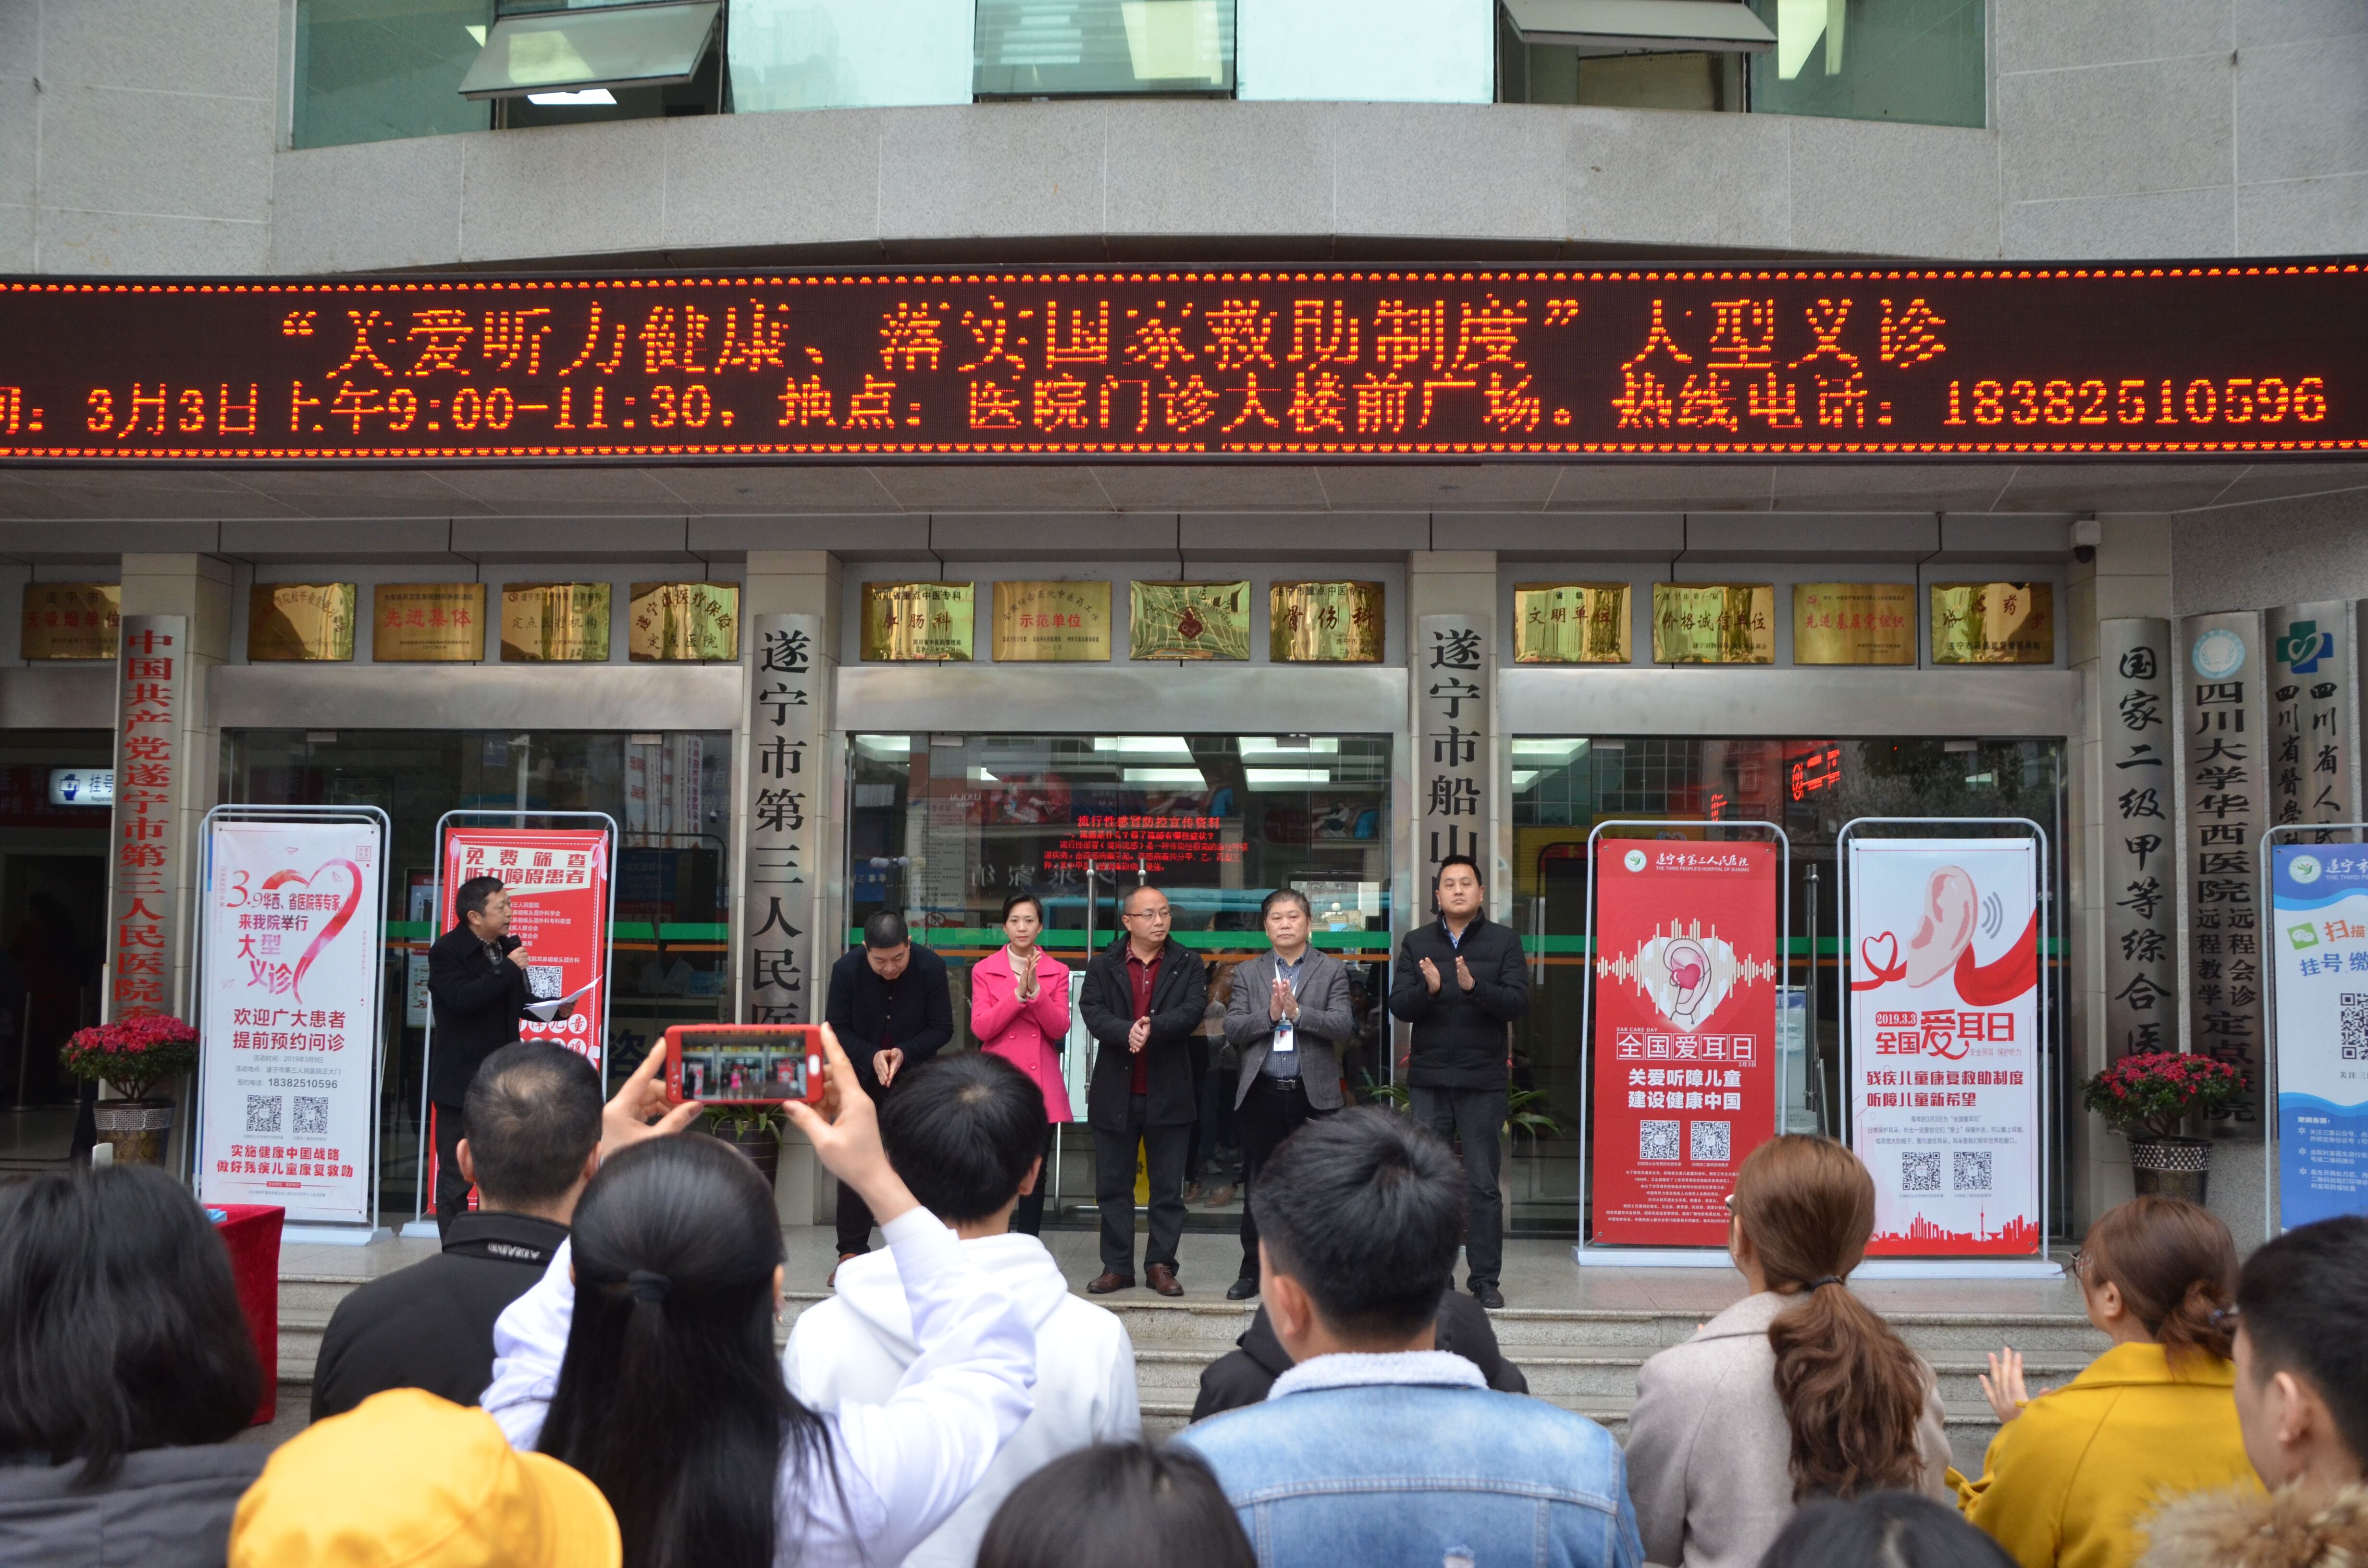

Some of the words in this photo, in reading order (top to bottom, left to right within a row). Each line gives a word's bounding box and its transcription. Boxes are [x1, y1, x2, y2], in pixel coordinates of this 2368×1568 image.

[873, 589, 962, 600] 四川省重点中医专科
[1276, 585, 1366, 597] 遂宁市重点中医专科
[1555, 591, 1584, 600] 省级
[1663, 592, 1719, 600] 遂宁市第一届
[384, 607, 472, 628] 先进集体
[635, 588, 734, 632] 遂宁市医疗保险
[1282, 605, 1375, 632] 骨伤科
[1528, 606, 1612, 624] 文明单位
[511, 616, 598, 629] 定点医疗机构
[882, 612, 951, 632] 肛肠科
[1020, 613, 1082, 628] 示范单位
[1662, 611, 1766, 631] 价格诚信单位
[1805, 612, 1904, 631] 先进基层党组织
[647, 633, 718, 650] 定点医院
[1427, 628, 1482, 895] 遂宁市船山
[89, 774, 114, 793] 挂号
[2195, 681, 2252, 904] 四川大学华西医院
[1077, 815, 1220, 829] 流行性感冒防控宣传资料
[466, 847, 587, 868] 免费筛查
[1655, 852, 1750, 867] 遂宁市第三人民医院
[238, 913, 309, 931] 来我院举行
[237, 933, 281, 959] 大型
[2196, 908, 2222, 1006] 远程教学
[2227, 907, 2257, 1007] 远程会诊
[247, 958, 293, 995] 义诊
[234, 1008, 346, 1029] 欢迎广大患者
[1876, 1013, 1917, 1025] 2019.3.3
[233, 1031, 345, 1052] 提前预约问诊
[1875, 1008, 2015, 1061] 全国爱耳日
[1617, 1033, 1753, 1060] 全国爱耳日
[1970, 1048, 1994, 1057] 安全用耳
[1997, 1048, 2022, 1057] 保护听力
[268, 1078, 338, 1089] 18382510596
[1628, 1068, 1741, 1087] 关爱听障儿童
[1867, 1070, 2024, 1086] 残疾儿童康复救助制度
[1628, 1090, 1741, 1110] 建设健康中国
[1867, 1092, 1977, 1107] 听障儿童新希望
[231, 1144, 340, 1161] 实施健康中国战略
[216, 1160, 354, 1178] 做好残疾儿童康复救助
